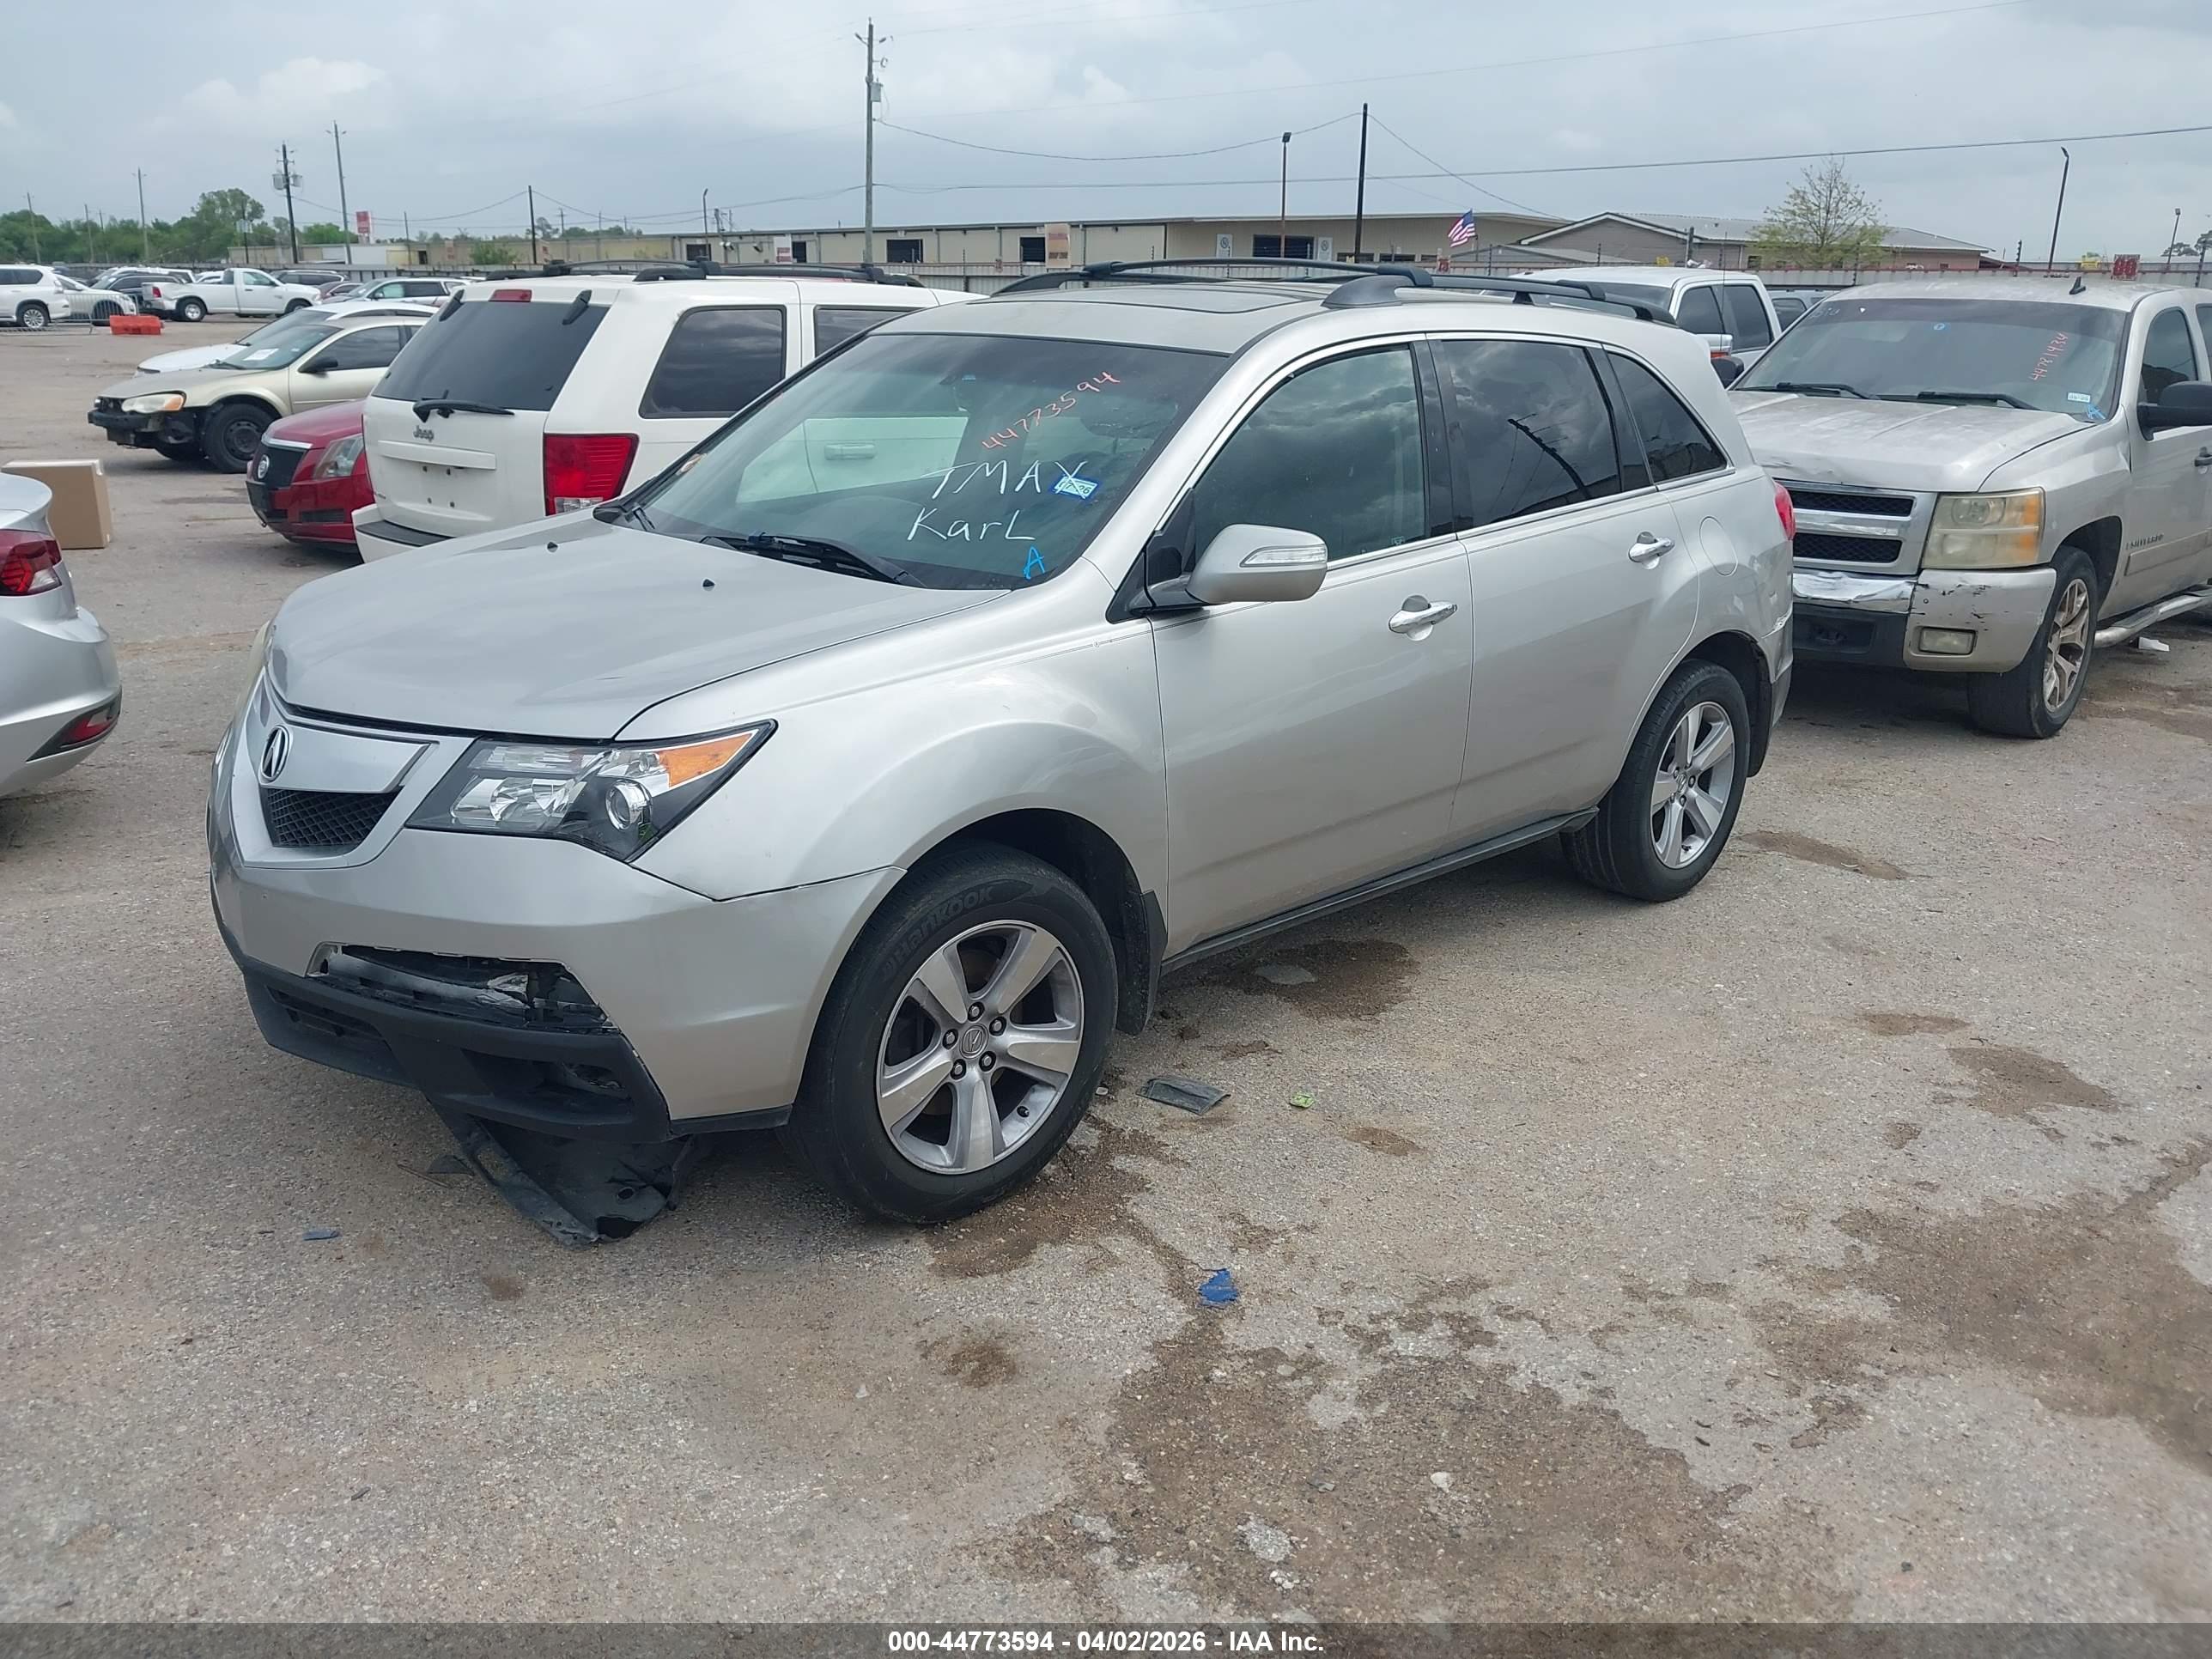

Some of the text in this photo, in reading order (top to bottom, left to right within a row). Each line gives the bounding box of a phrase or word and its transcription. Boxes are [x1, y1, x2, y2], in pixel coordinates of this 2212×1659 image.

[981, 371, 1121, 449] 44773594
[920, 459, 1088, 500] TMAX
[1023, 546, 1045, 580] A
